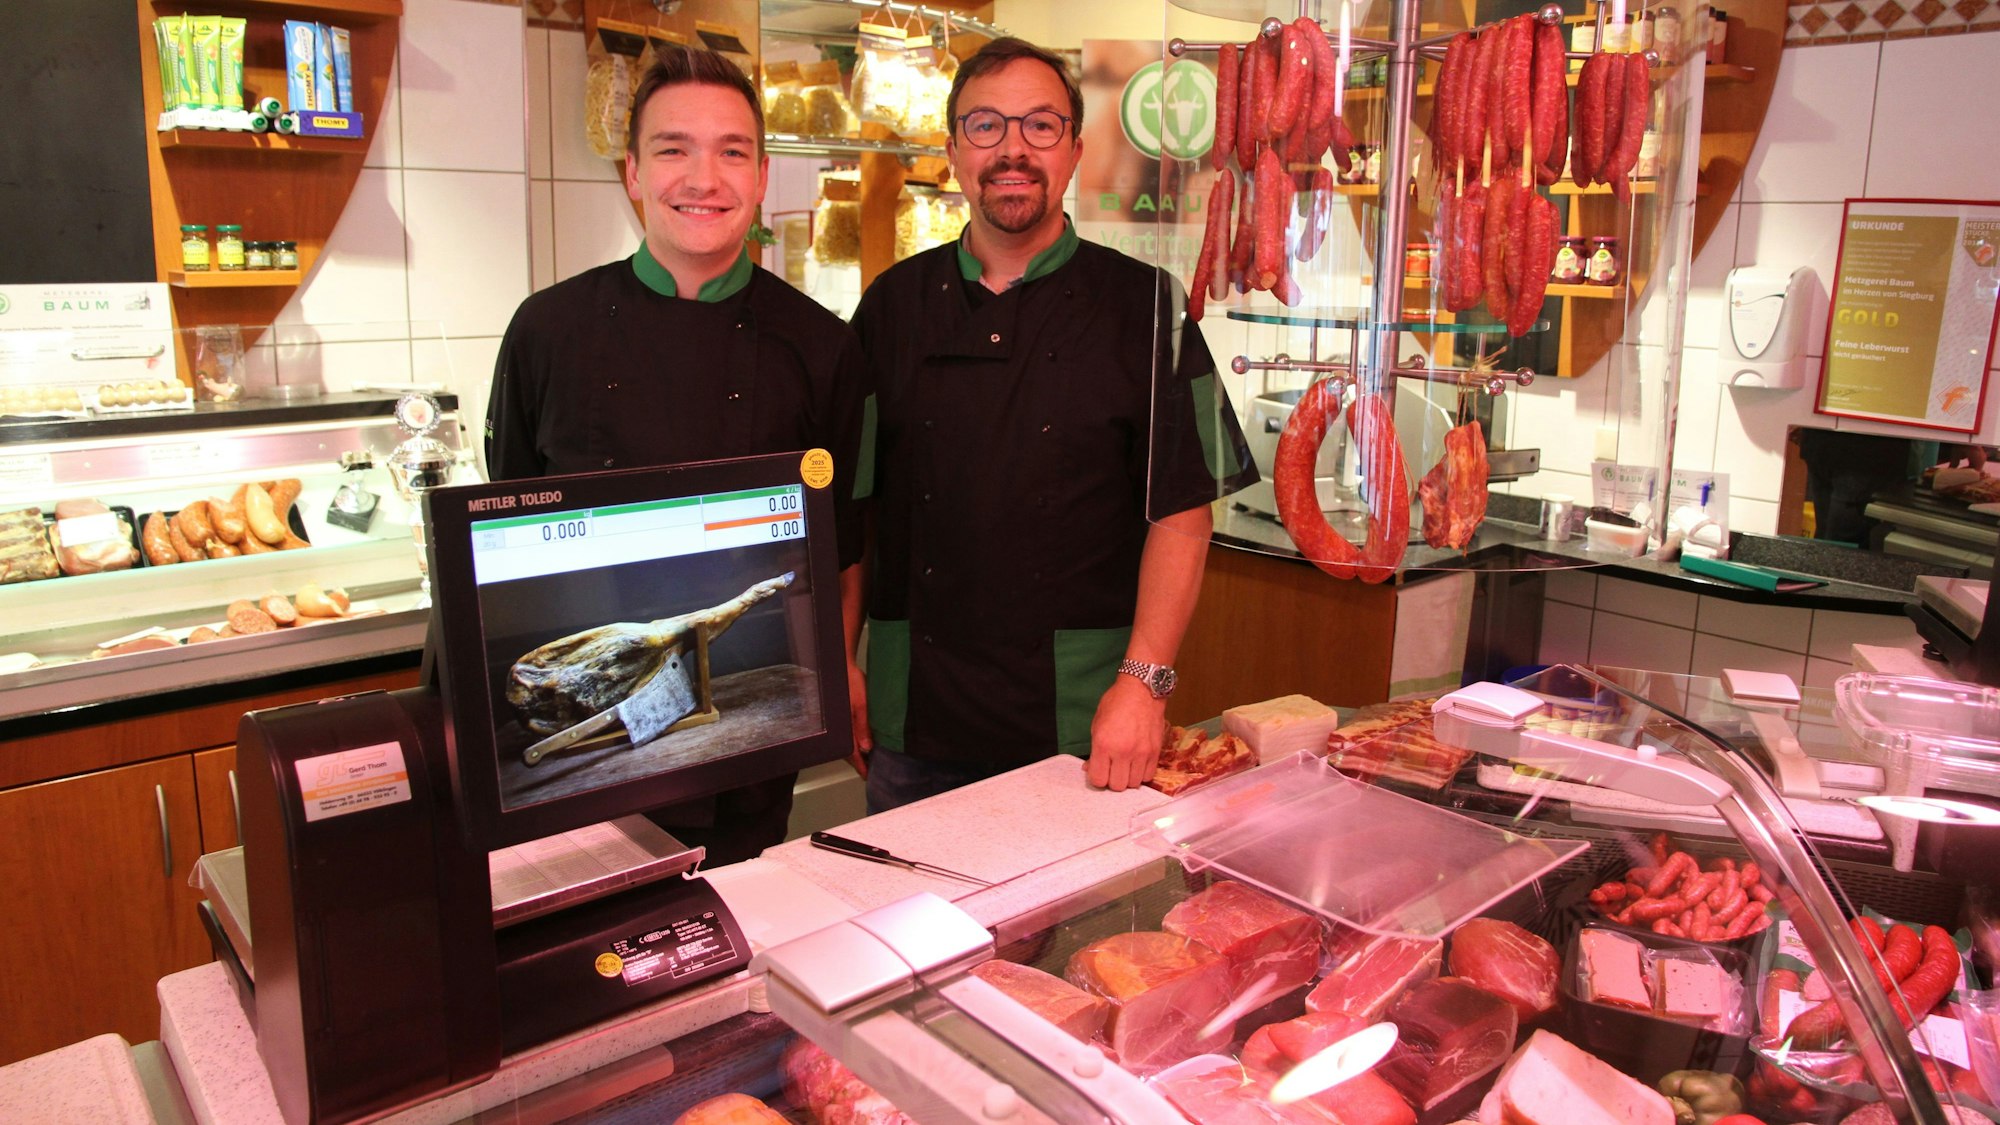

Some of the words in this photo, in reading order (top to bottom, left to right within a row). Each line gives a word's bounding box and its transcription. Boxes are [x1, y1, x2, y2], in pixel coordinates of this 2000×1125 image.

[316, 118, 346, 126] THOMY
[1852, 220, 1904, 231] URKUNDE
[1844, 275, 1888, 286] Metzgerei
[1889, 278, 1914, 287] Baum
[1854, 288, 1881, 297] Herzen
[1899, 291, 1934, 301] Siegburg
[44, 300, 110, 311] BAUM
[1837, 308, 1899, 328] GOLD
[1834, 339, 1858, 349] Feine
[1860, 341, 1909, 354] Leberwurst
[468, 495, 517, 512] METTLER
[520, 490, 563, 506] TOLEDO
[769, 495, 796, 512] 0.00
[542, 520, 586, 541] 0.000
[771, 520, 799, 537] 0.00
[349, 766, 366, 774] Gerd
[368, 761, 387, 770] Thom
